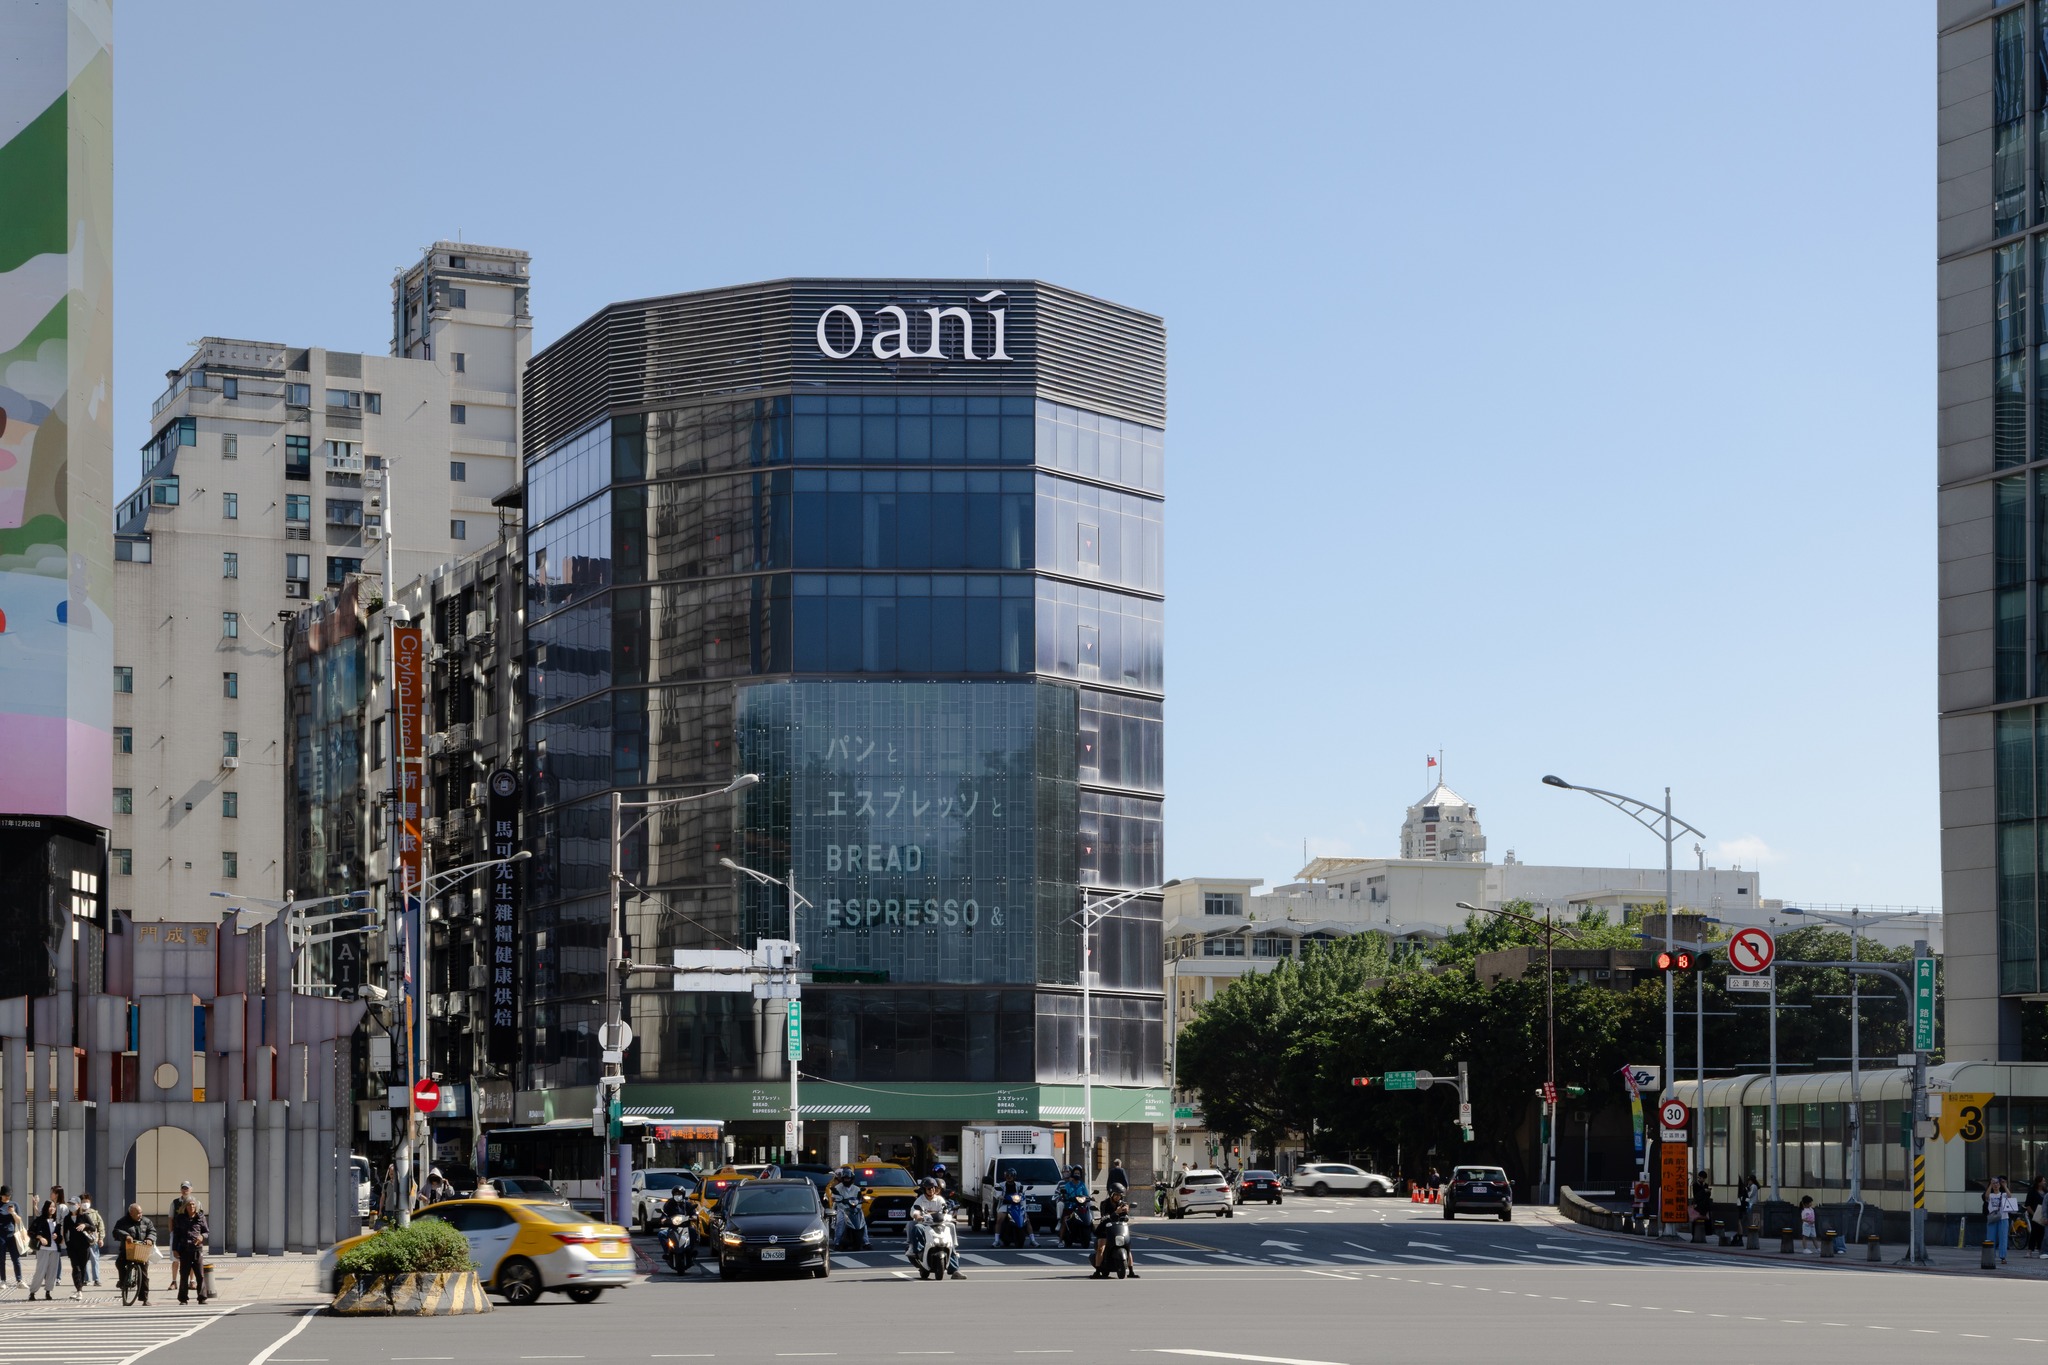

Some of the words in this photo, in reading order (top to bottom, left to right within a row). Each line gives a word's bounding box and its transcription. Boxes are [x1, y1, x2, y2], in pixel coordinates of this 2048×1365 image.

[397, 635, 418, 697] CityInn
[401, 704, 416, 750] Hotel
[827, 845, 922, 872] BREAD
[826, 899, 979, 926] ESPRESSO
[991, 906, 1004, 926] &
[1679, 955, 1688, 968] 18
[1732, 980, 1770, 988] 公車除外
[1666, 1109, 1682, 1121] 30
[1960, 1106, 1984, 1141] 3
